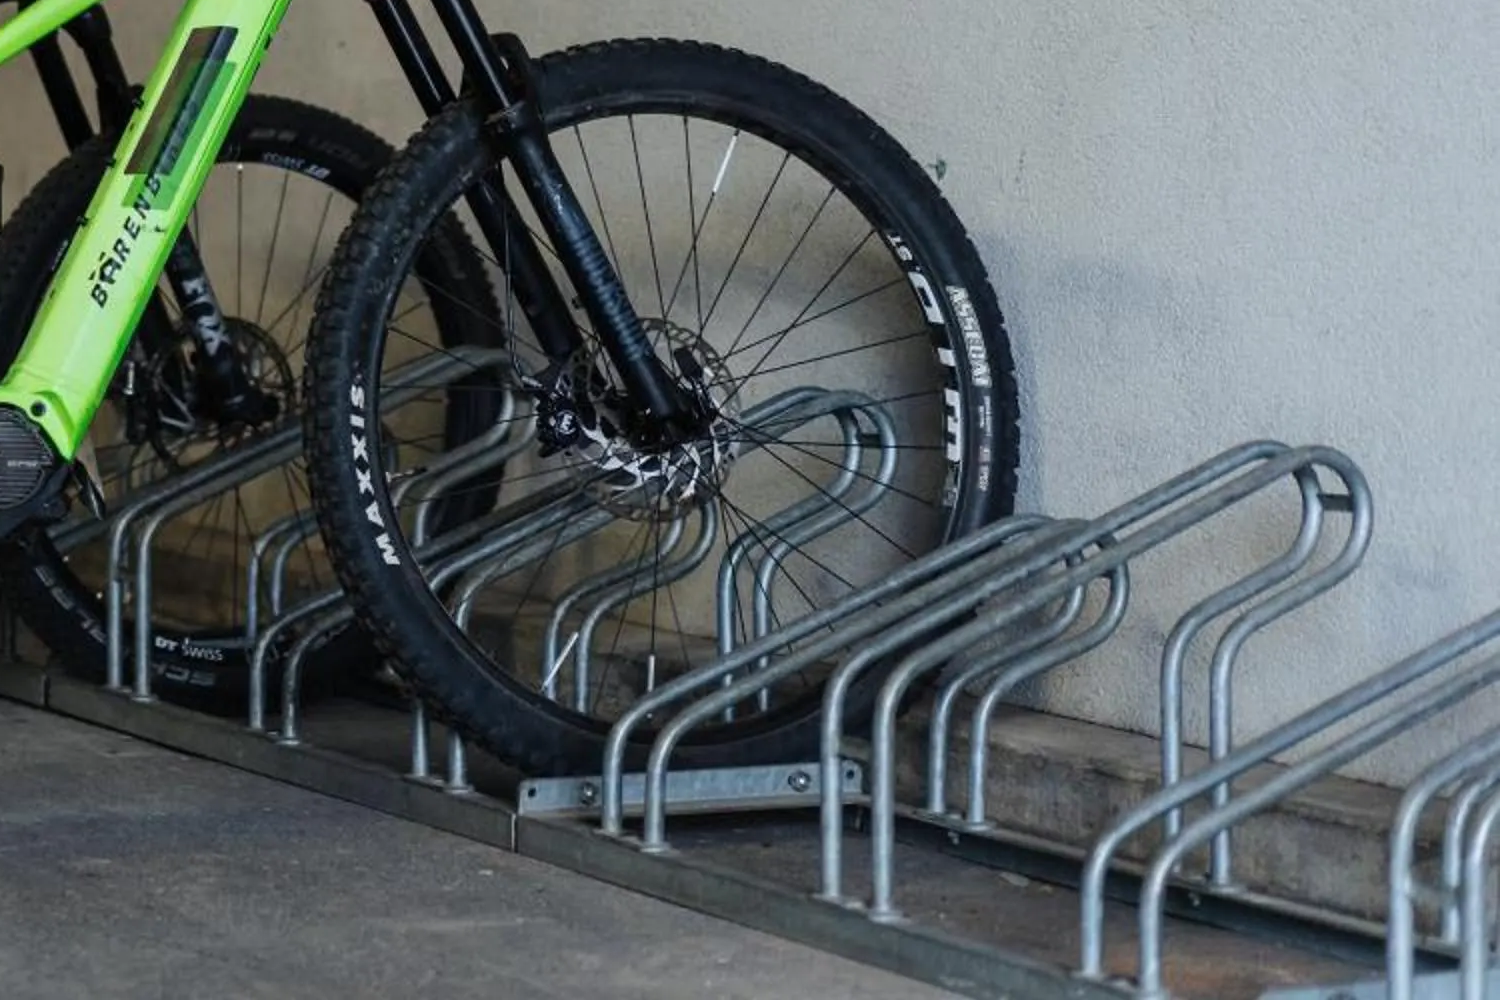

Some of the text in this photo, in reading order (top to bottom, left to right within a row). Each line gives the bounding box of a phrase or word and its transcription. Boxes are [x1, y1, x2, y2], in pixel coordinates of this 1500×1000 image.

[182, 275, 232, 357] FOX
[349, 383, 402, 566] MAXXIS
[155, 636, 225, 662] DT SWISS
